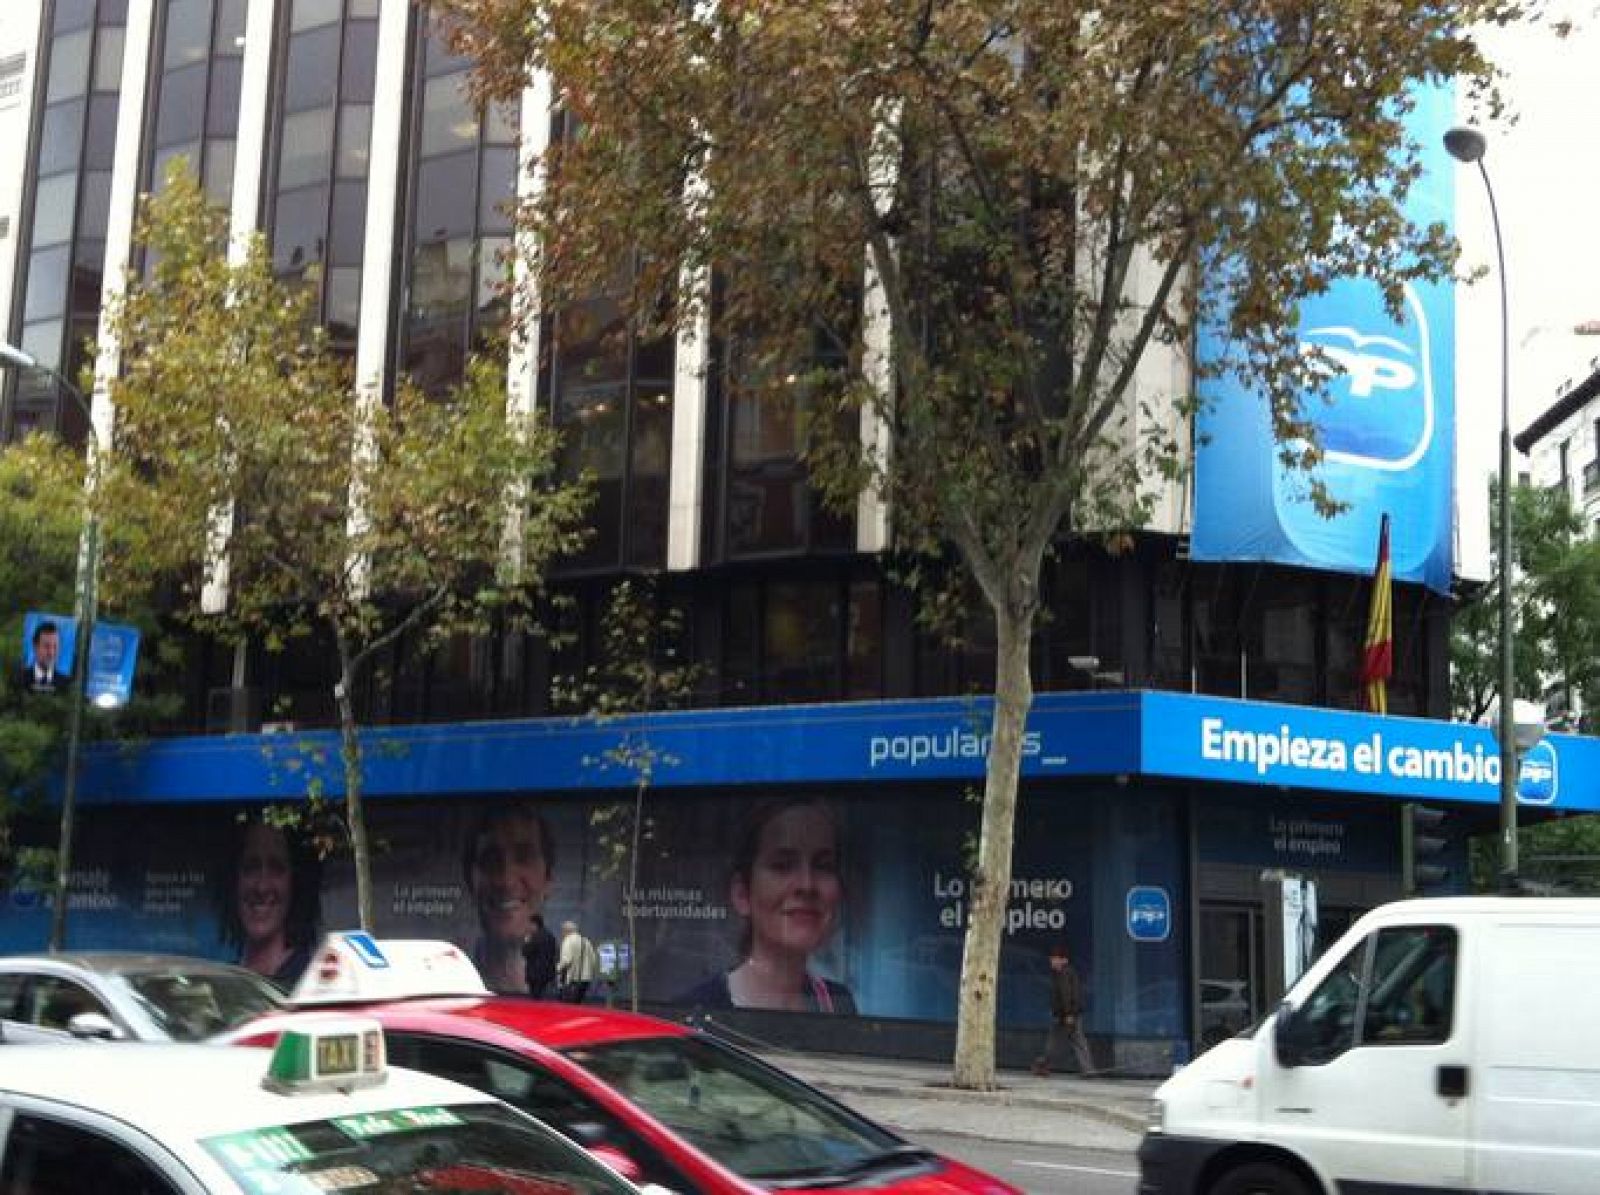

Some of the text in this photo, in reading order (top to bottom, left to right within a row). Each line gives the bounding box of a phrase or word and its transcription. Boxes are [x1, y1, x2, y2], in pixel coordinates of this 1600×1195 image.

[1201, 716, 1500, 784] Empieza el cambio
[934, 873, 964, 898] Lo
[940, 900, 962, 927] el
